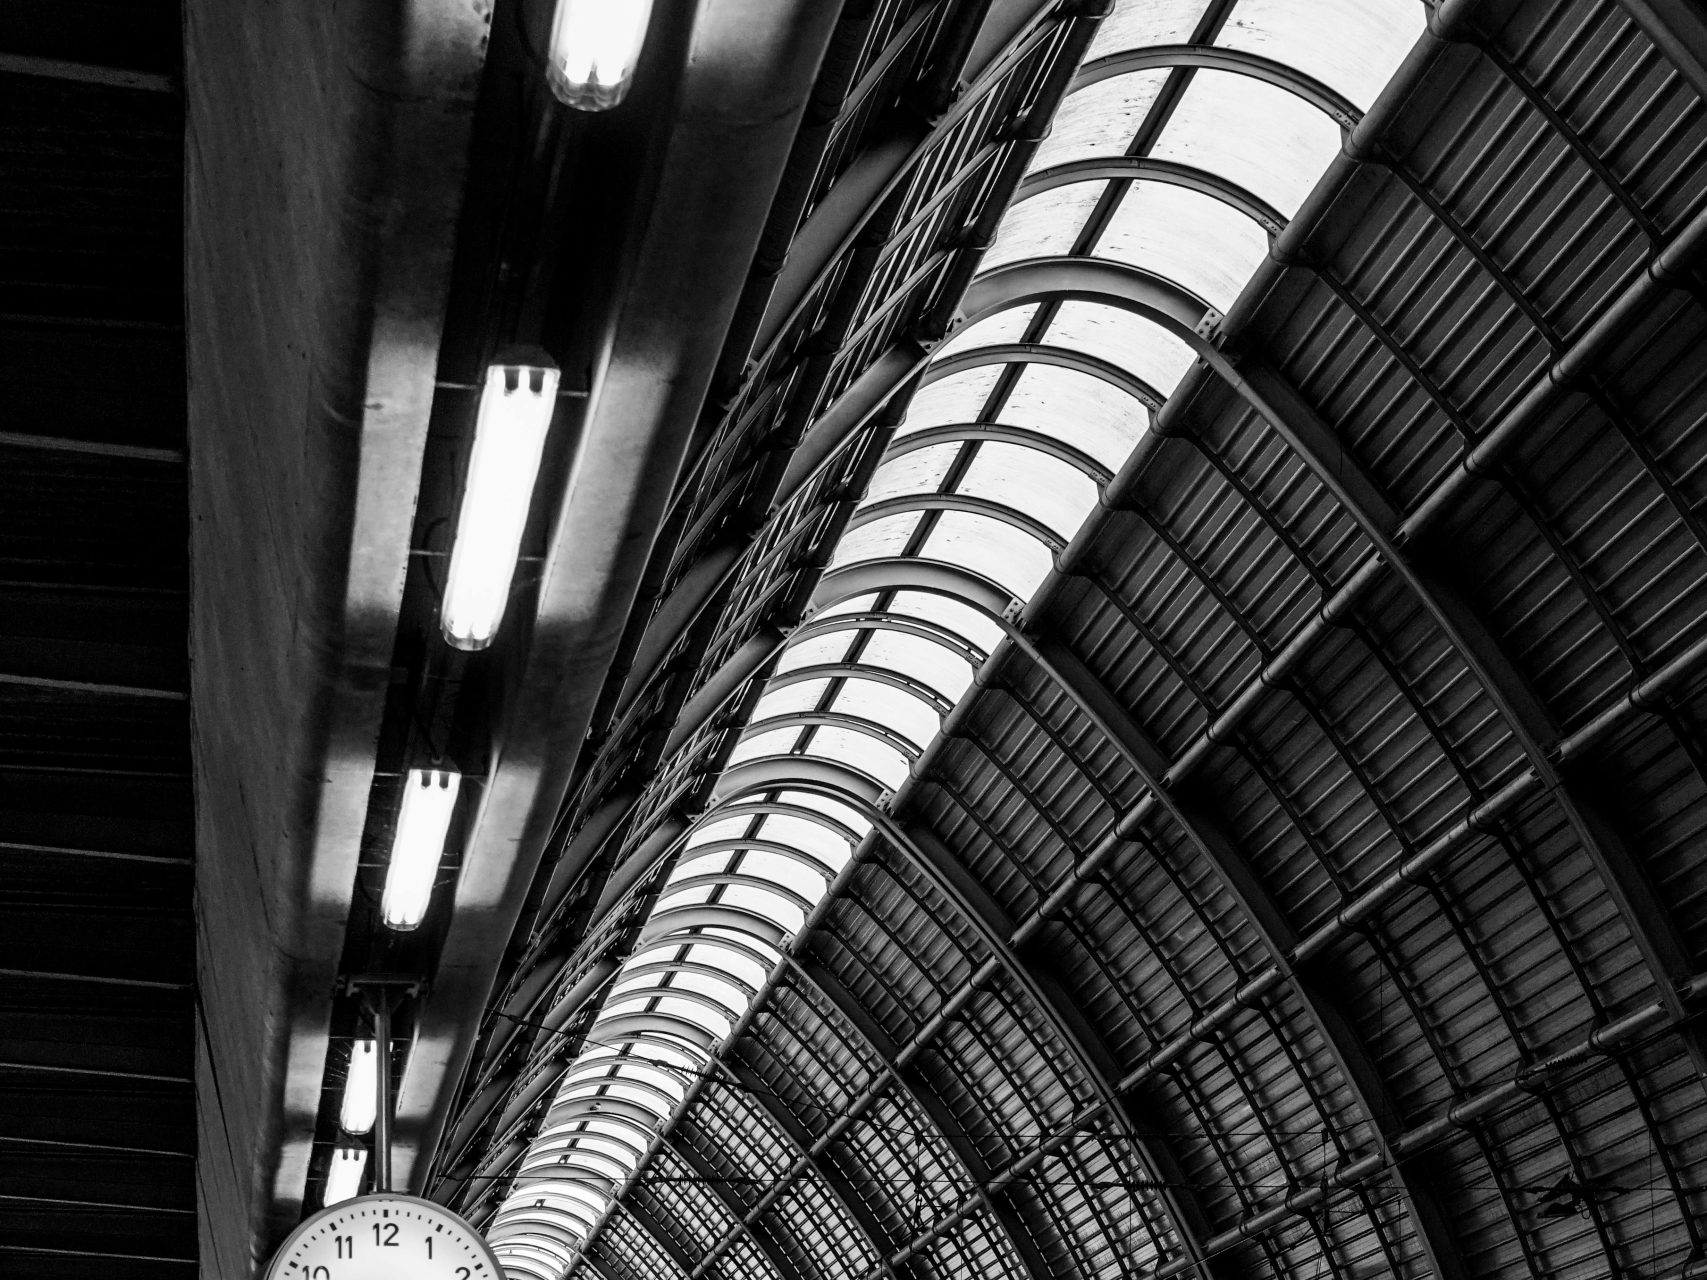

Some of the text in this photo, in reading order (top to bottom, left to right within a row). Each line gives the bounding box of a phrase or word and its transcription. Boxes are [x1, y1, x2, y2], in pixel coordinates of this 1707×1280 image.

[372, 1222, 400, 1247] 12
[334, 1235, 353, 1260] 11
[425, 1236, 433, 1260] 1
